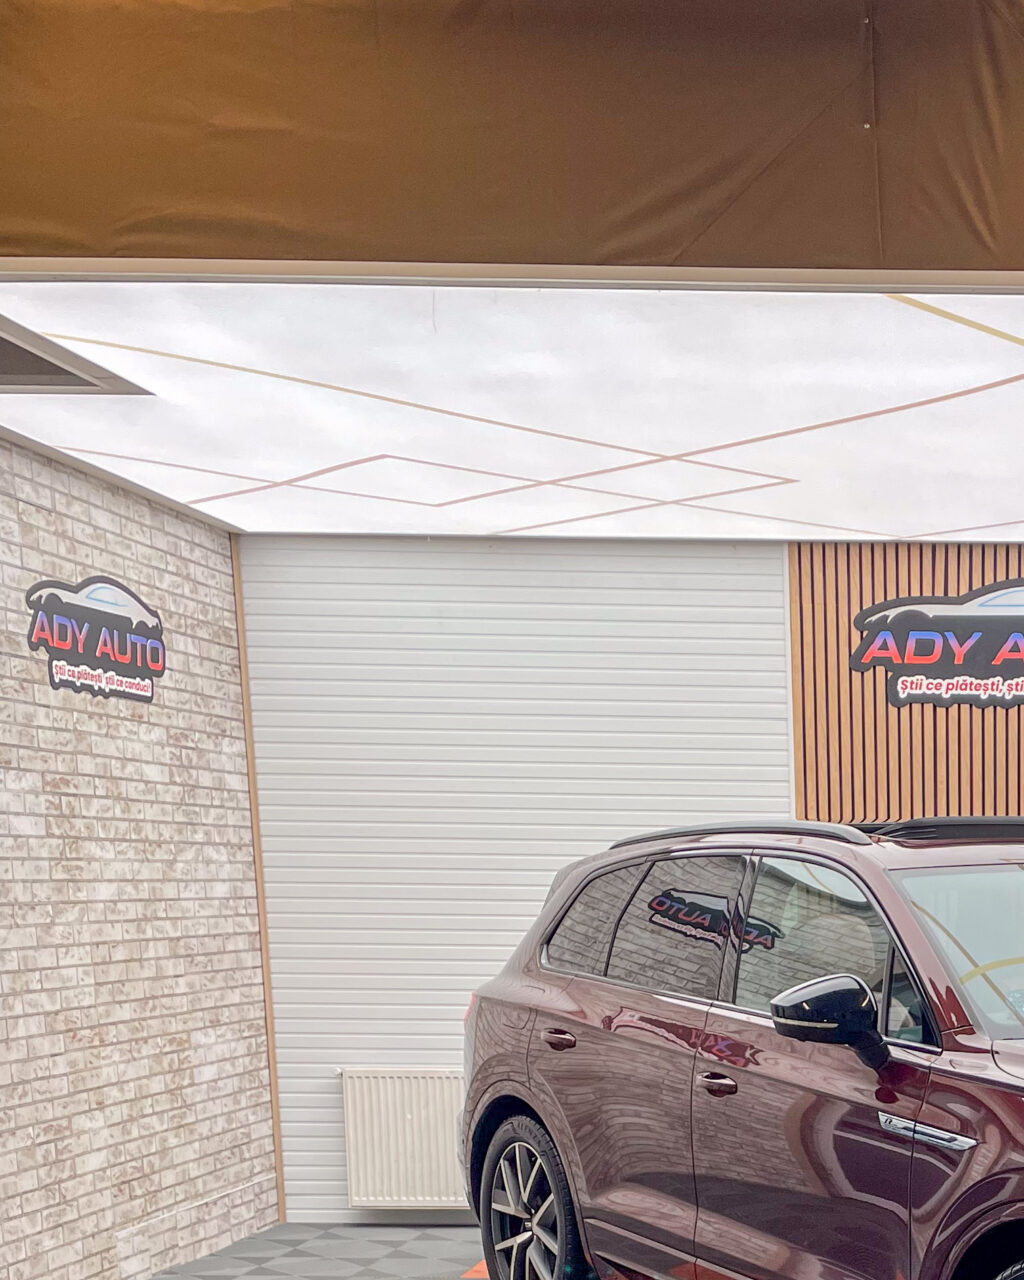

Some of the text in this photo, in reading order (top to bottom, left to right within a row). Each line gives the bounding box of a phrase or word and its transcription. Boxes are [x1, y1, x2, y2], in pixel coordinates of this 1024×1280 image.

[31, 611, 164, 671] ADY AUTO
[861, 630, 982, 665] ADY
[900, 678, 923, 695] Știi
[926, 682, 943, 692] ce
[945, 678, 1003, 695] plătești,
